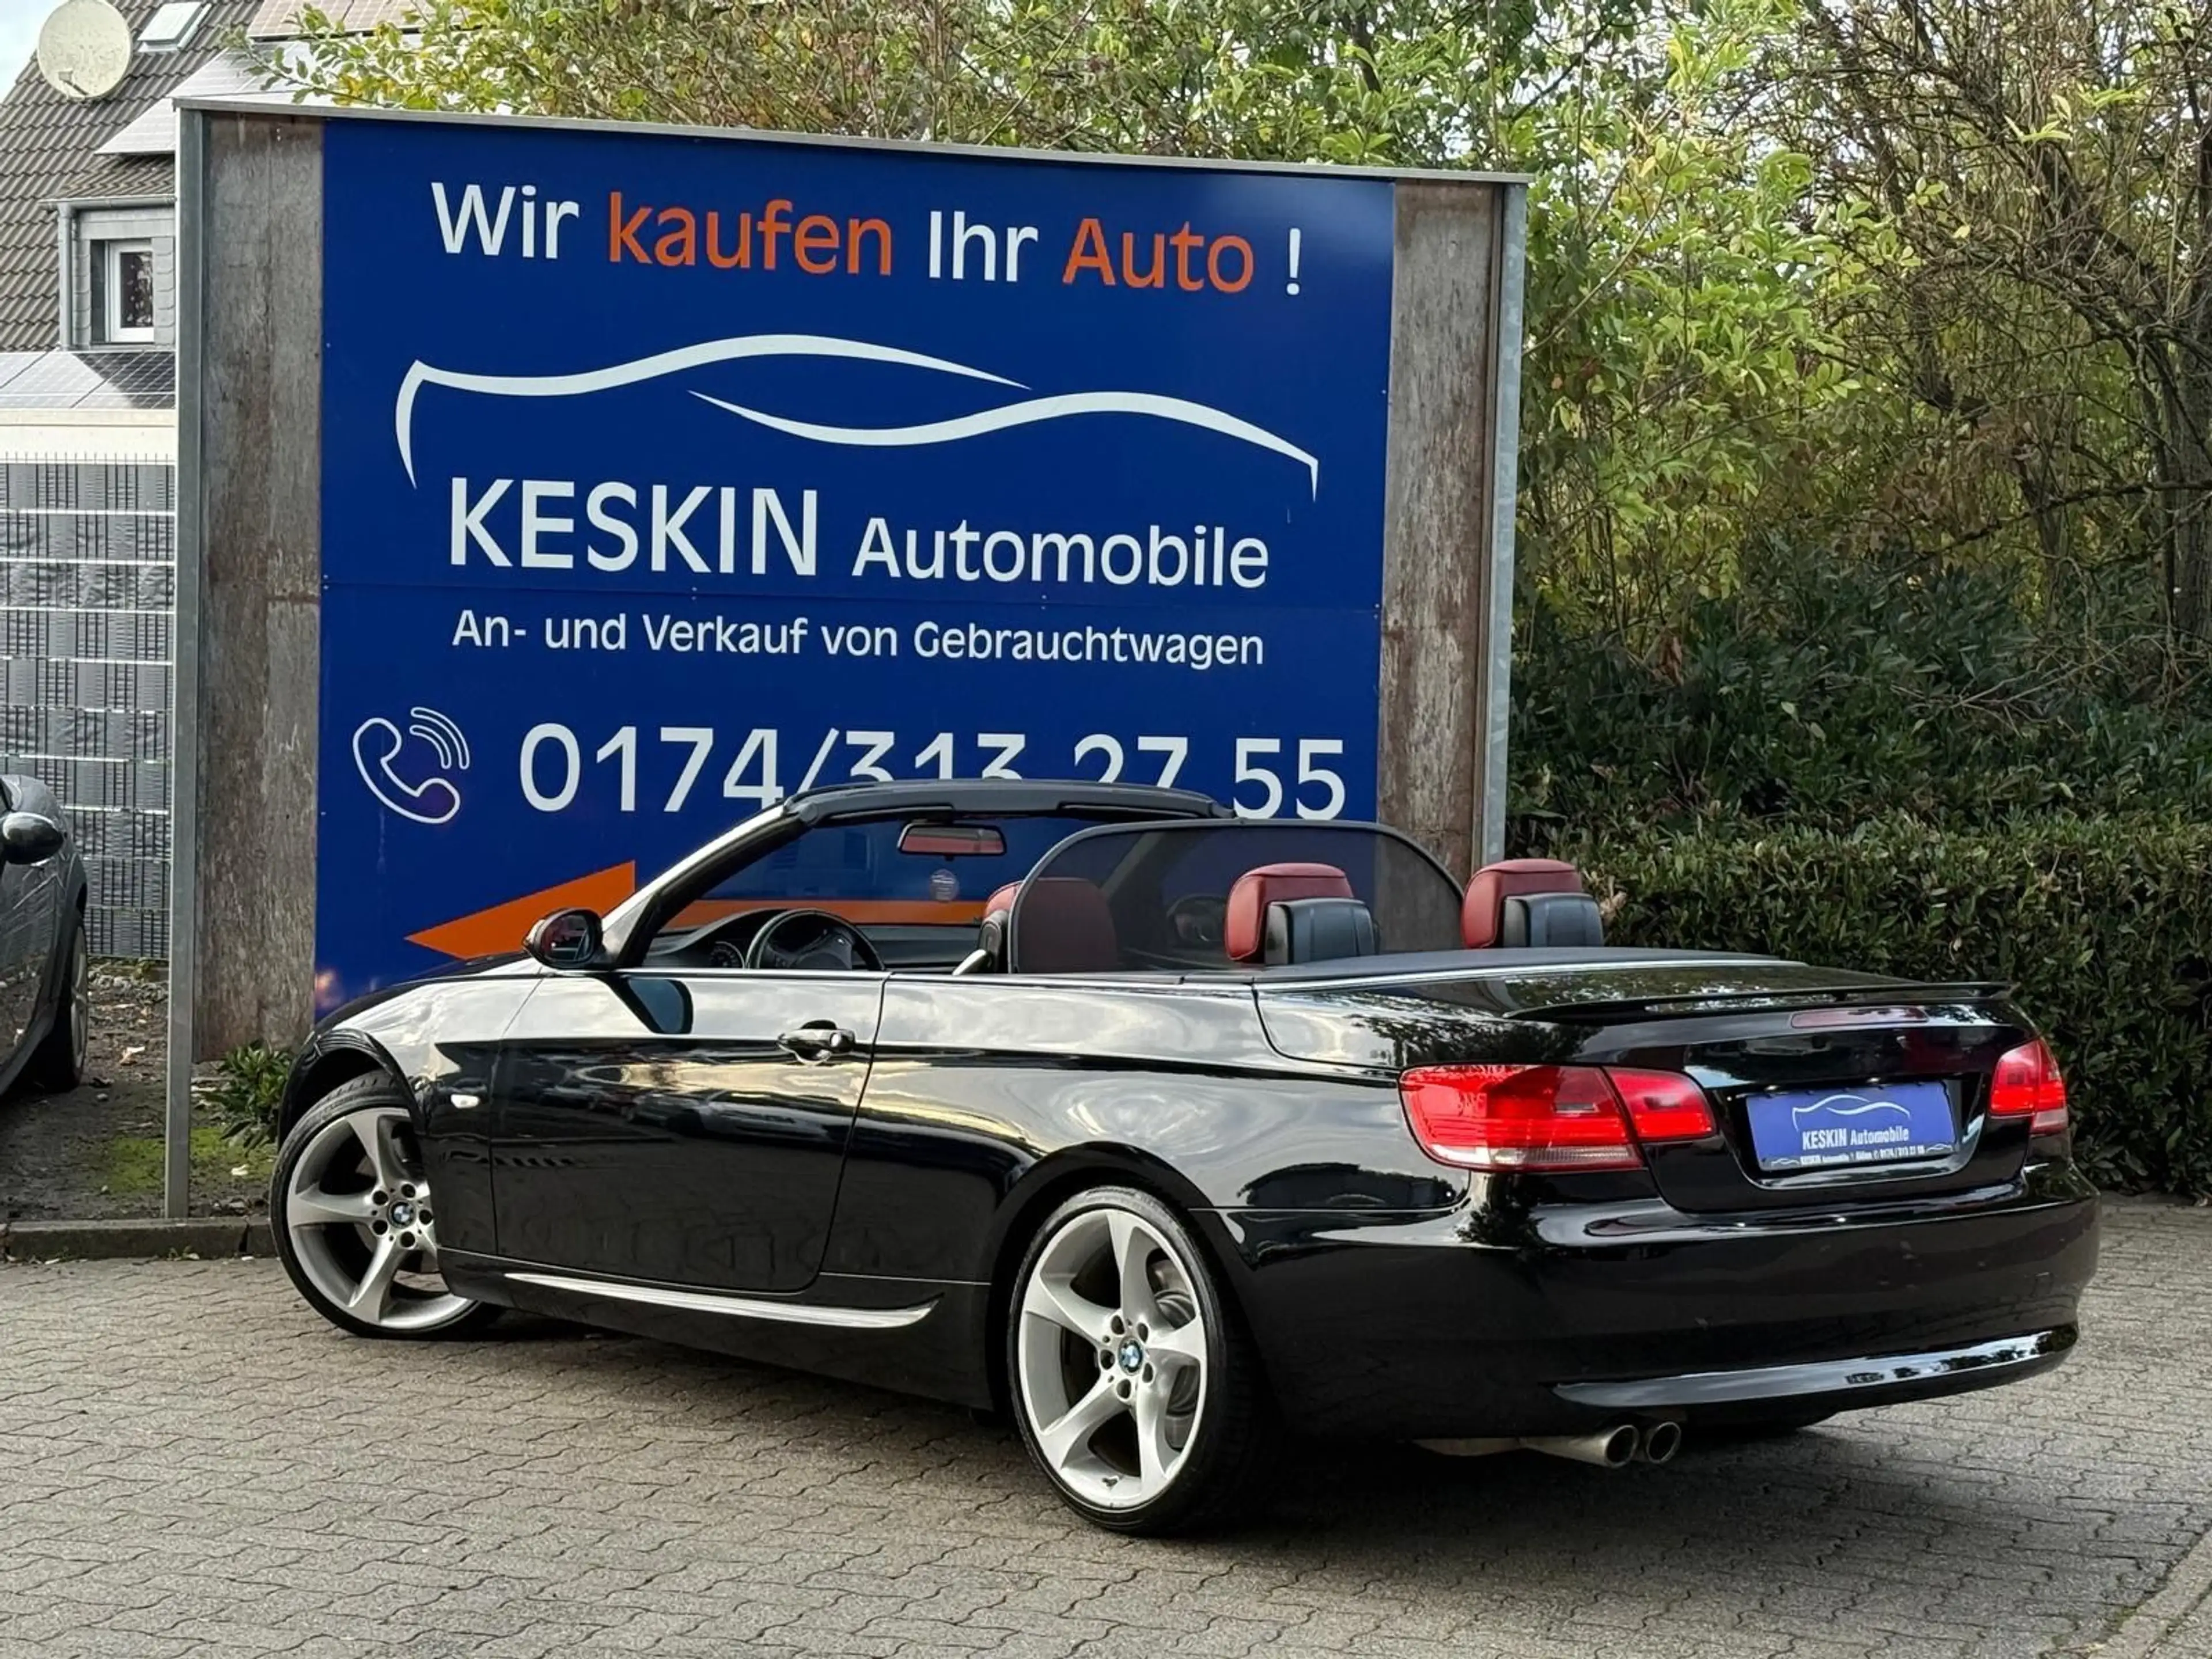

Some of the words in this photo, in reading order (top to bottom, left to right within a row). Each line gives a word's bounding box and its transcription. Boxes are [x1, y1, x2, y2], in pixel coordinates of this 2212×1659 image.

[431, 183, 579, 259] Wir
[611, 192, 891, 275] kaufen
[930, 211, 1038, 282] Ihr
[1063, 219, 1253, 293] Auto
[1287, 228, 1301, 295] !
[451, 478, 817, 575] KESKIN
[852, 518, 1268, 588] Automobile
[453, 611, 526, 646] An-
[546, 613, 626, 650] und
[643, 614, 808, 654] Verkauf
[821, 626, 897, 656] von
[915, 621, 1263, 670] Gebrauchtwagen
[1233, 738, 1346, 820] 55
[1802, 1128, 1847, 1150] KESKIN
[1850, 1125, 1909, 1145] Automobile
